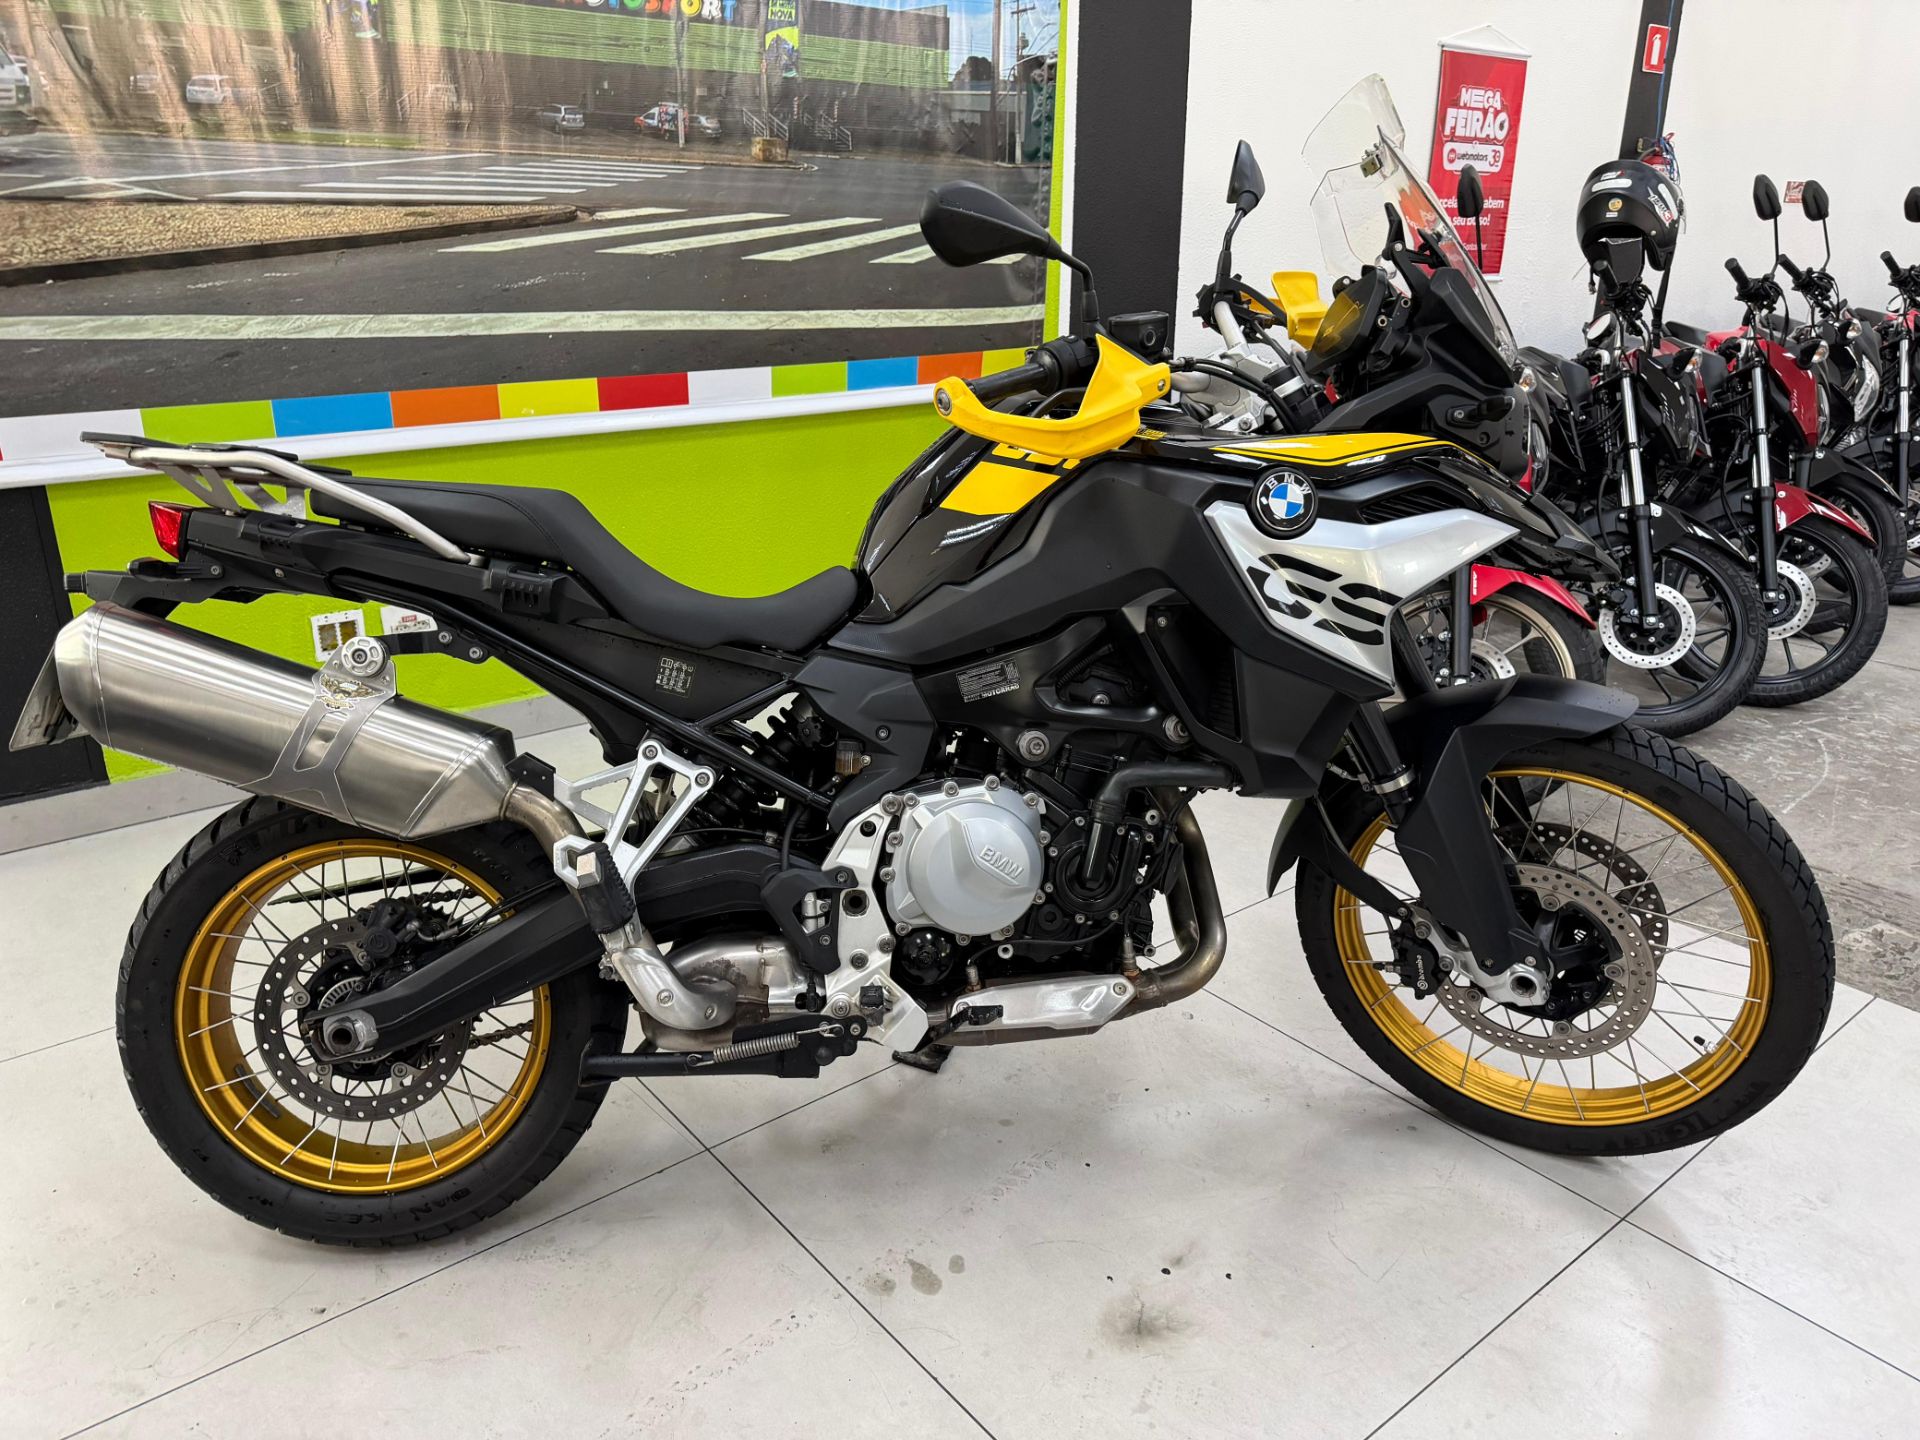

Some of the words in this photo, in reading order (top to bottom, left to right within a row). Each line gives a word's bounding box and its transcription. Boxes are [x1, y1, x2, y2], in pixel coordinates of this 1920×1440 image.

[1460, 87, 1501, 110] MEGA
[1444, 105, 1509, 140] FEIRÃO
[1457, 150, 1488, 162] webmotors
[1483, 196, 1504, 209] abem
[1466, 214, 1491, 226] boso!
[1246, 553, 1404, 646] GS
[980, 844, 1024, 880] BMW
